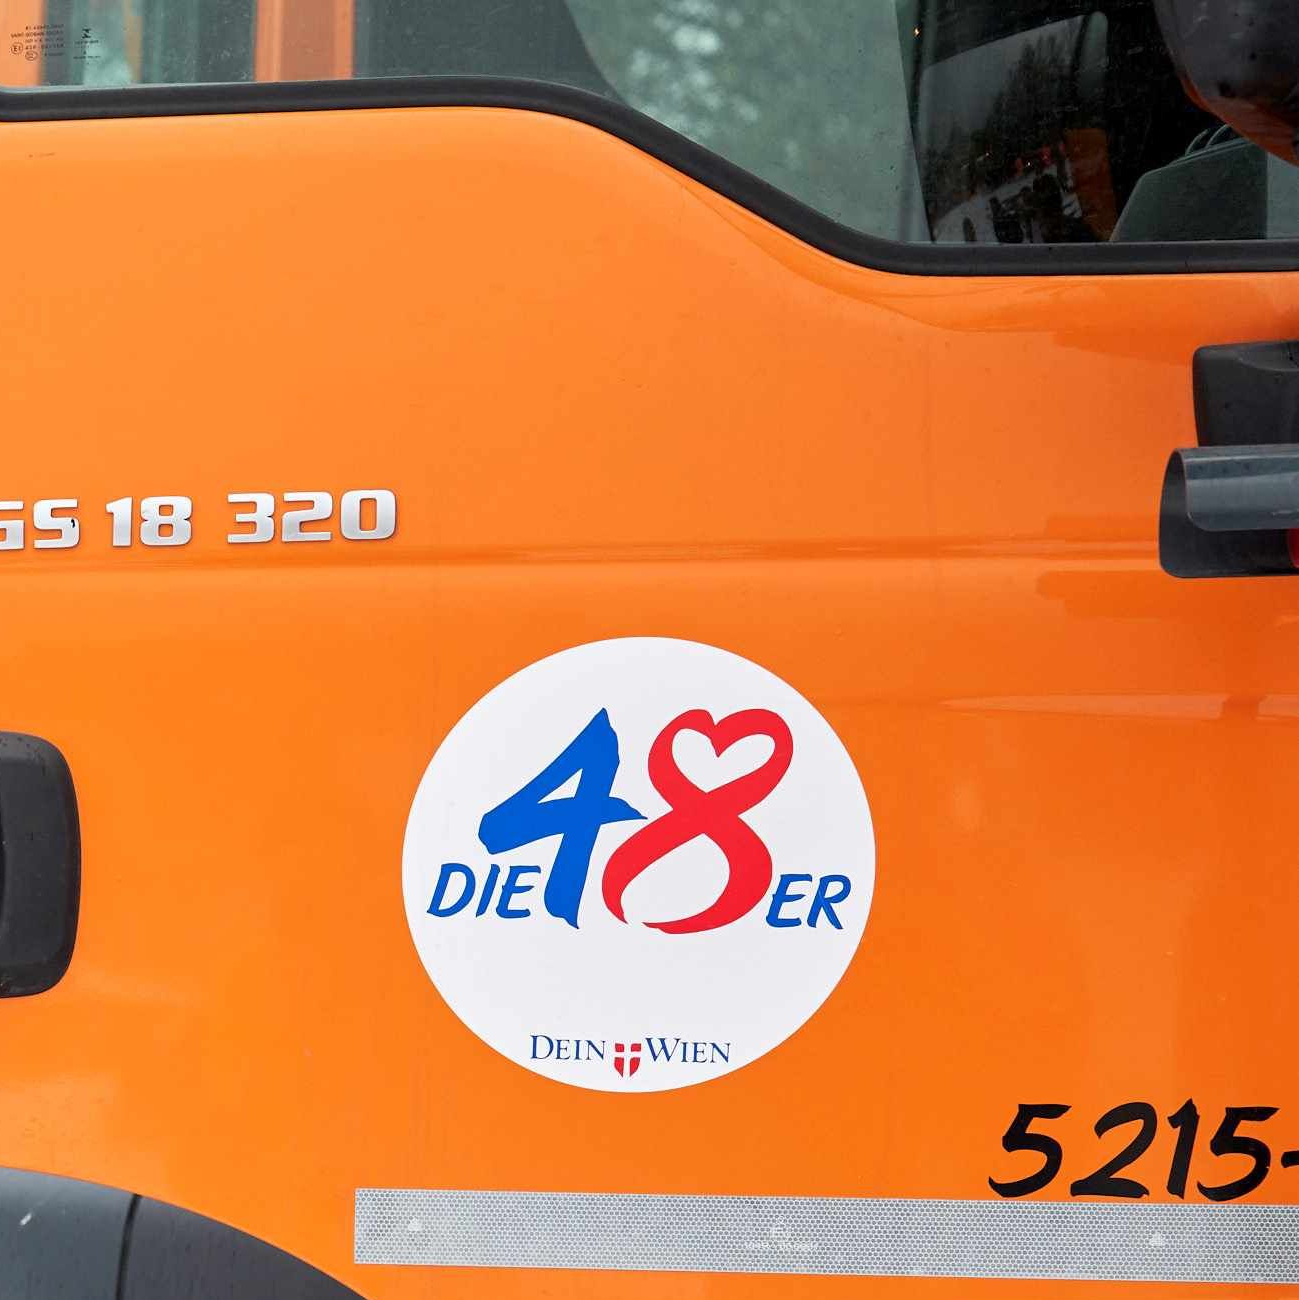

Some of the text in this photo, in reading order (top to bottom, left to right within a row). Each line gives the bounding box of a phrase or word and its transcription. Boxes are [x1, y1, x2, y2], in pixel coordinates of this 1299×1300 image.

[105, 495, 192, 547] 18
[227, 489, 397, 544] 320
[427, 863, 542, 919] DIE
[530, 1034, 731, 1064] DEIN WIEN
